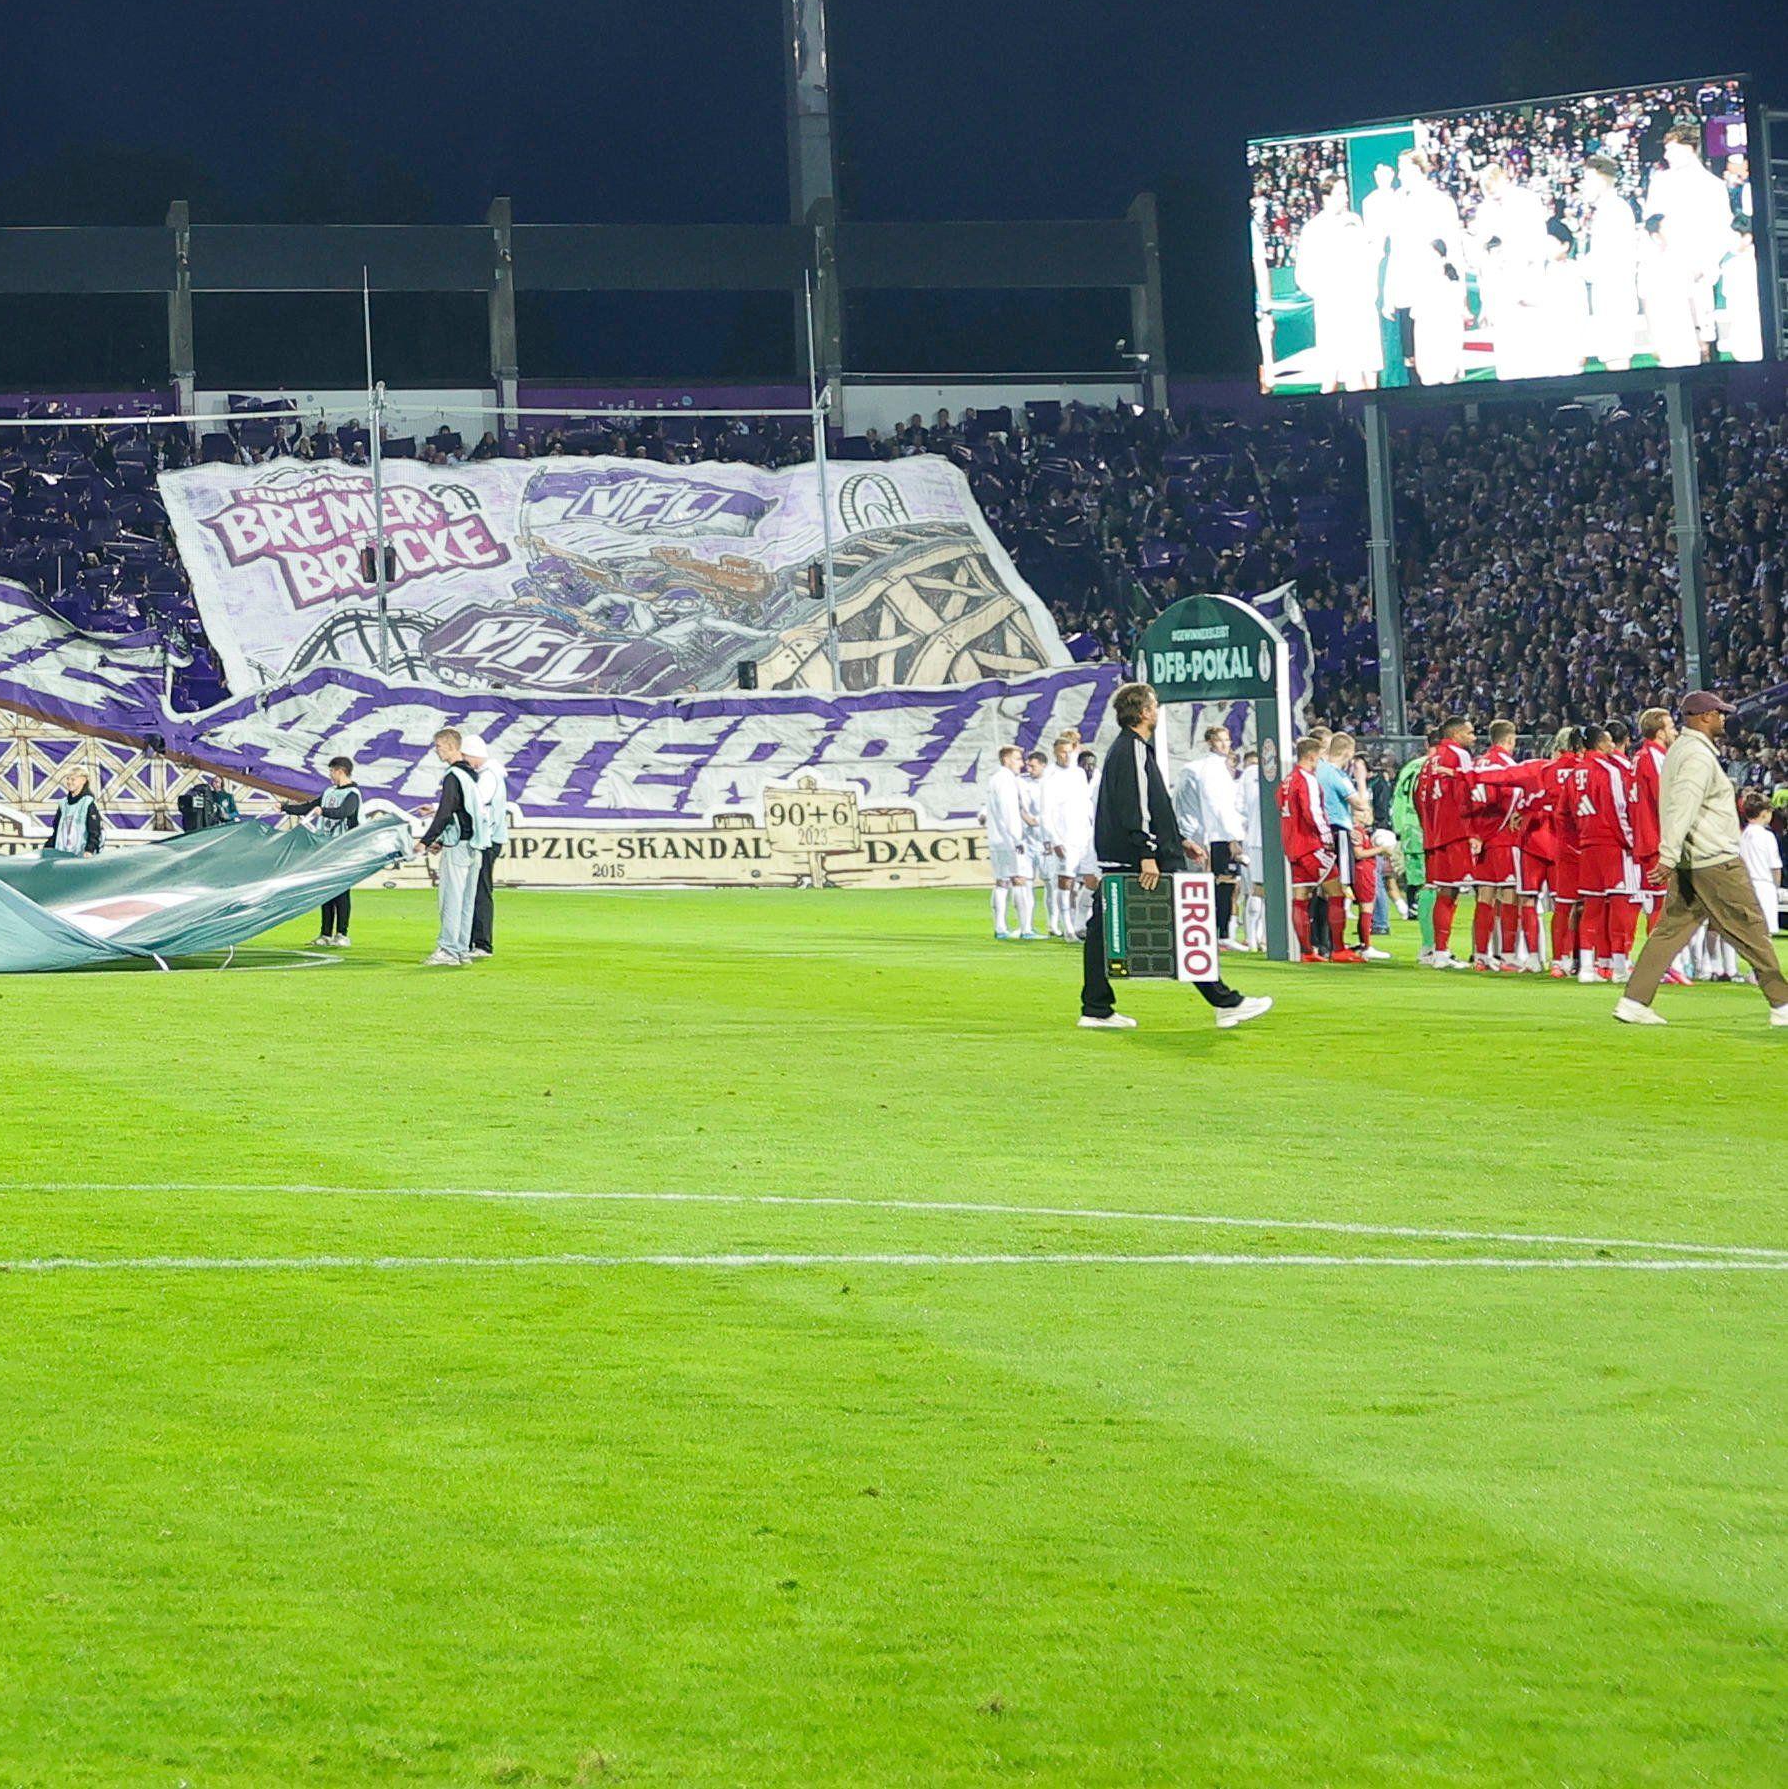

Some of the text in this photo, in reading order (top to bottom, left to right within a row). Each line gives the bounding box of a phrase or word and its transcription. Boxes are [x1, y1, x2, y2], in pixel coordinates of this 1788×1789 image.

[242, 477, 372, 503] FUNPARK
[1153, 645, 1254, 684] DFB-POKAL
[499, 836, 772, 860] IPZIG-SKANDAL
[797, 828, 828, 846] 2023
[592, 864, 626, 879] 2015
[1180, 881, 1212, 976] ERGO
